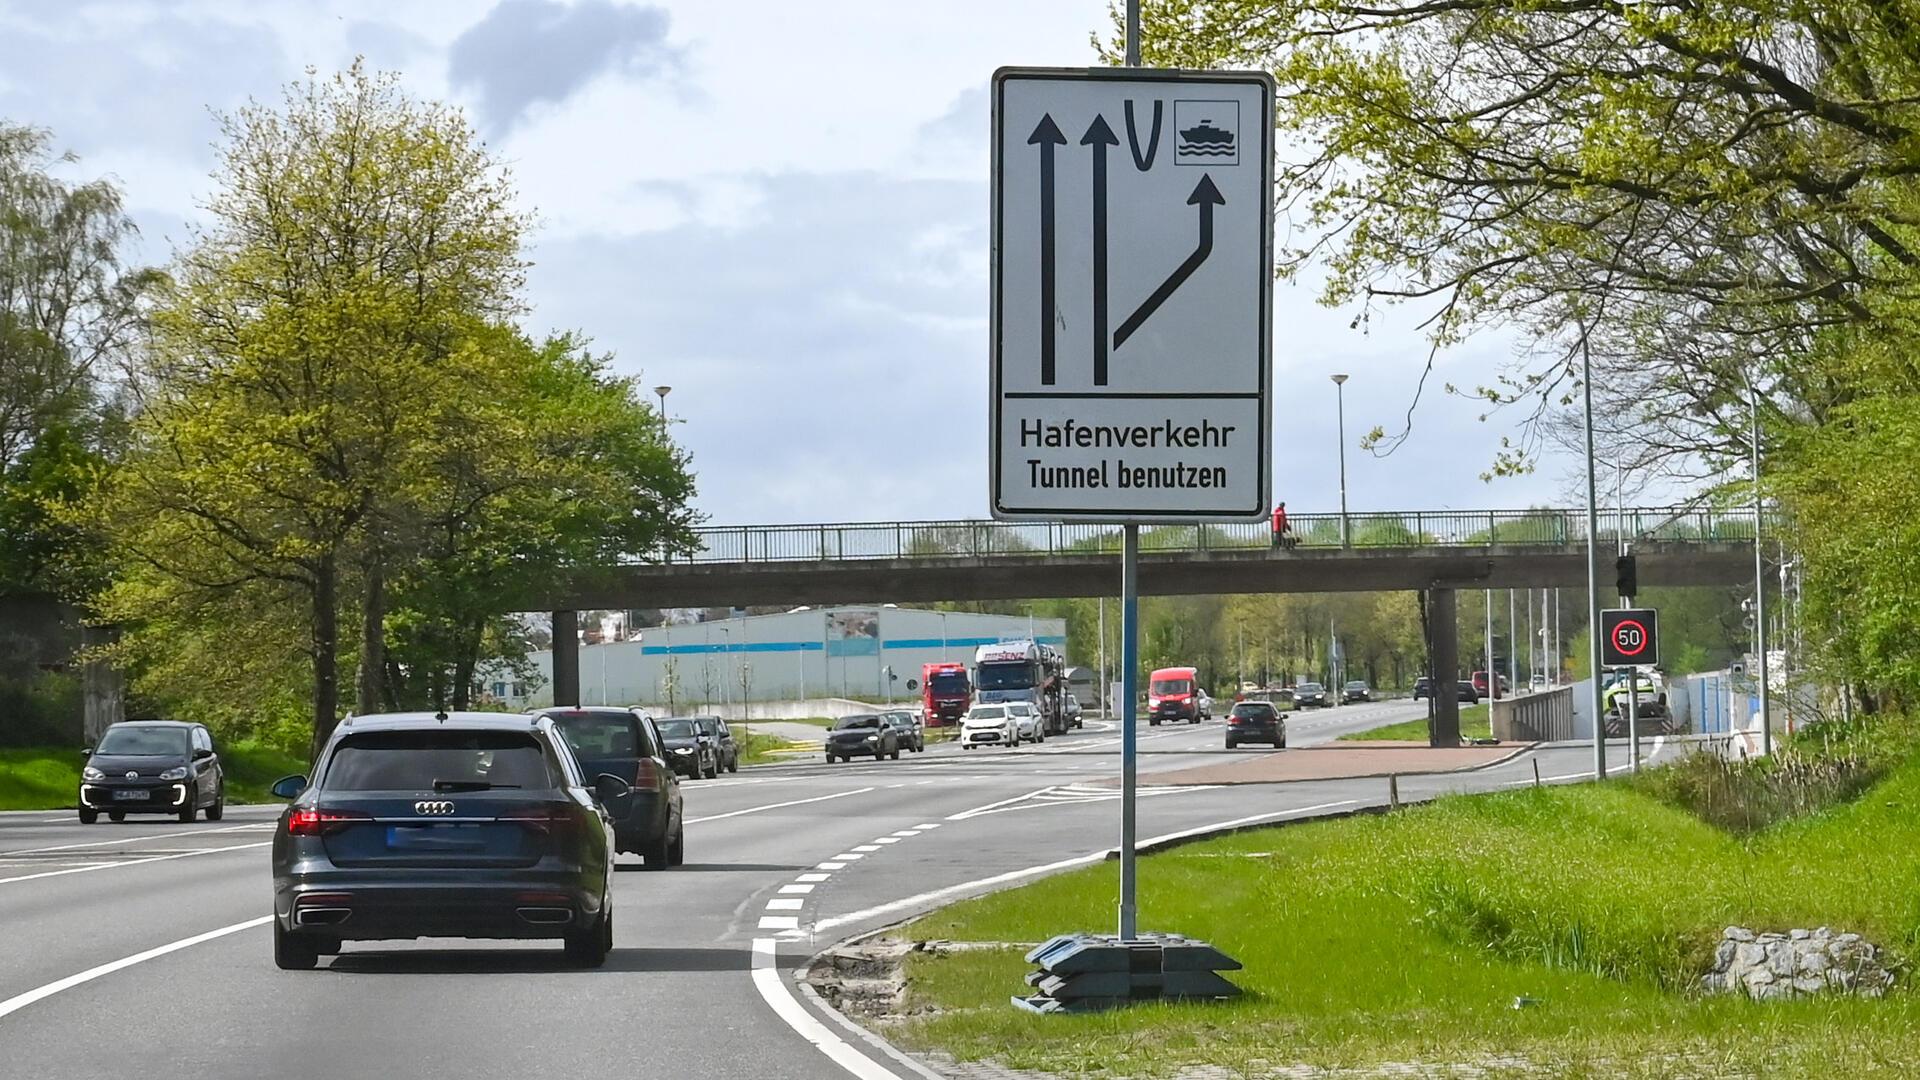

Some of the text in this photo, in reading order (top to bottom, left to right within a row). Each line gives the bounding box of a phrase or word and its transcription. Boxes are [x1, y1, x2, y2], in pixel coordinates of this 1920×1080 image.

[1021, 419, 1235, 447] Hafenverkehr
[1027, 459, 1227, 489] Tunnel benutzen
[1619, 630, 1640, 645] 50
